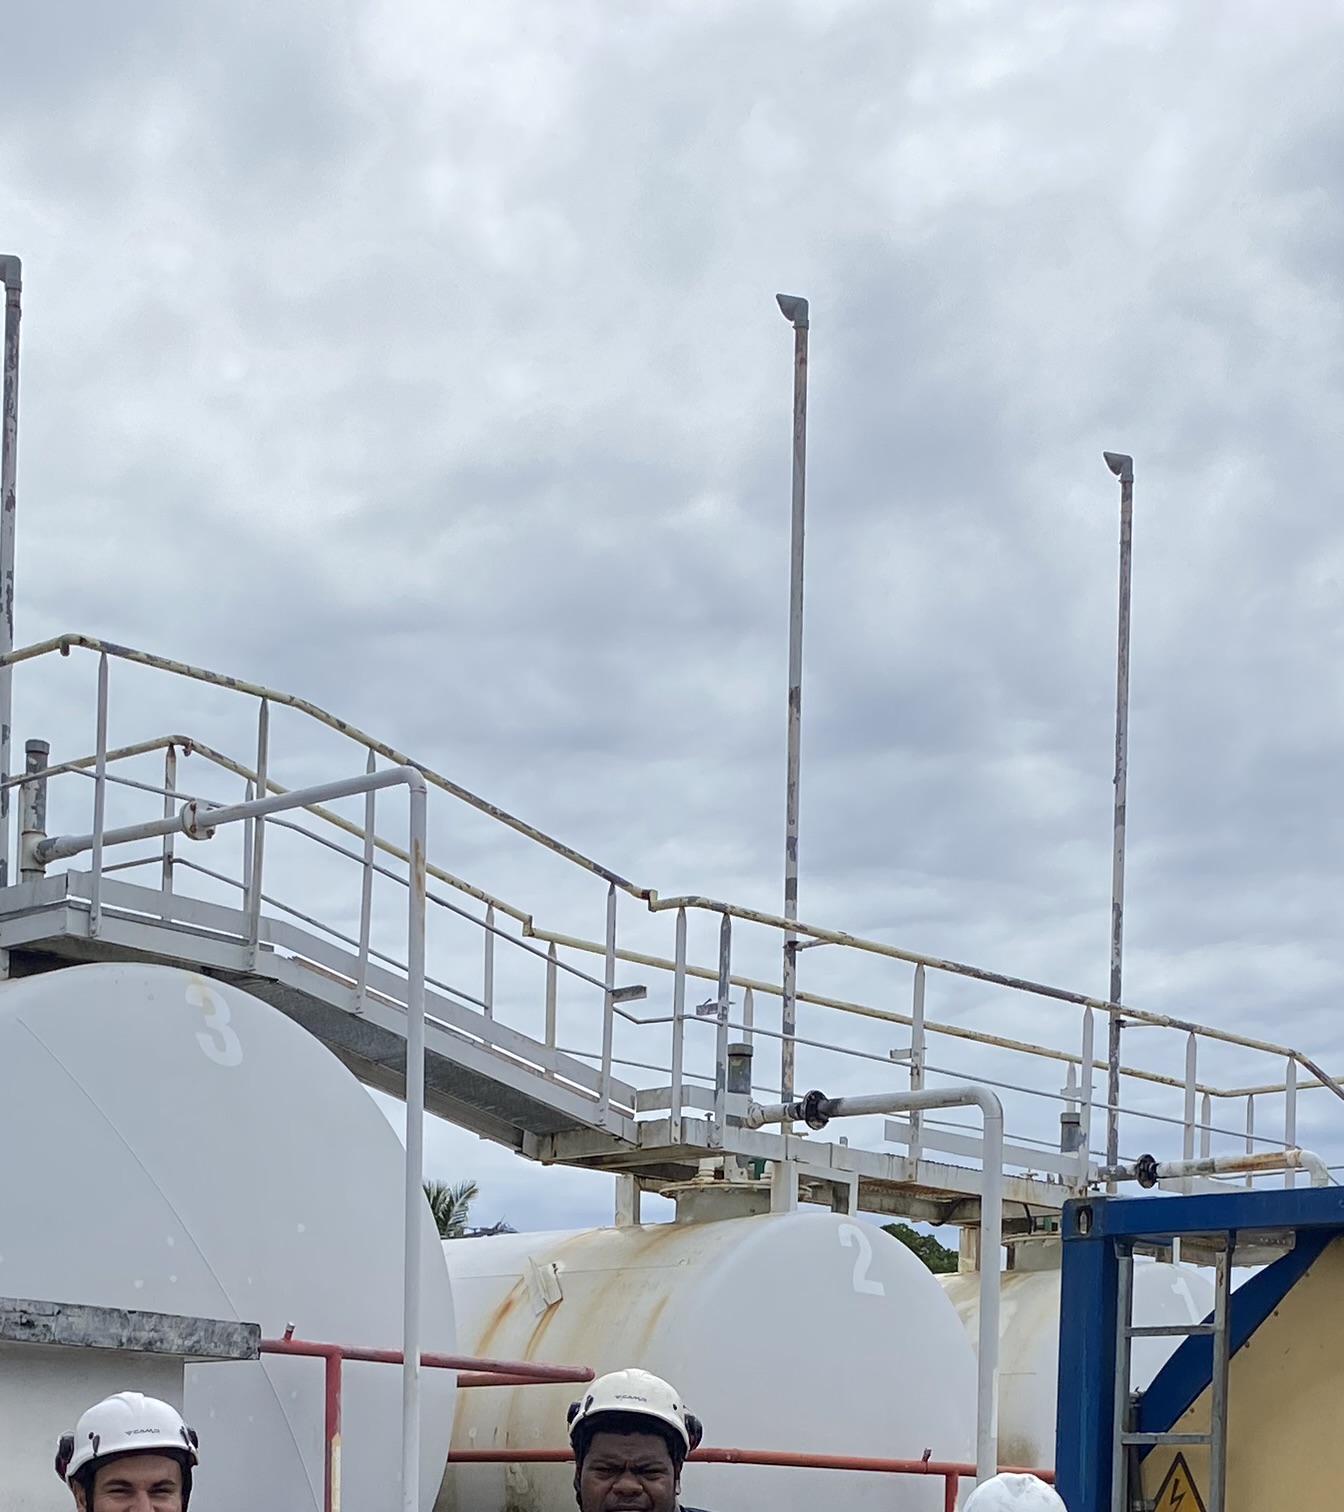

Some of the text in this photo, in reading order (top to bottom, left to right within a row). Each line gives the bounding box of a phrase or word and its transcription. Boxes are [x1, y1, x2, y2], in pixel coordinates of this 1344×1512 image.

[185, 983, 243, 1067] 3
[838, 1224, 885, 1296] 2
[1170, 1277, 1201, 1326] 1
